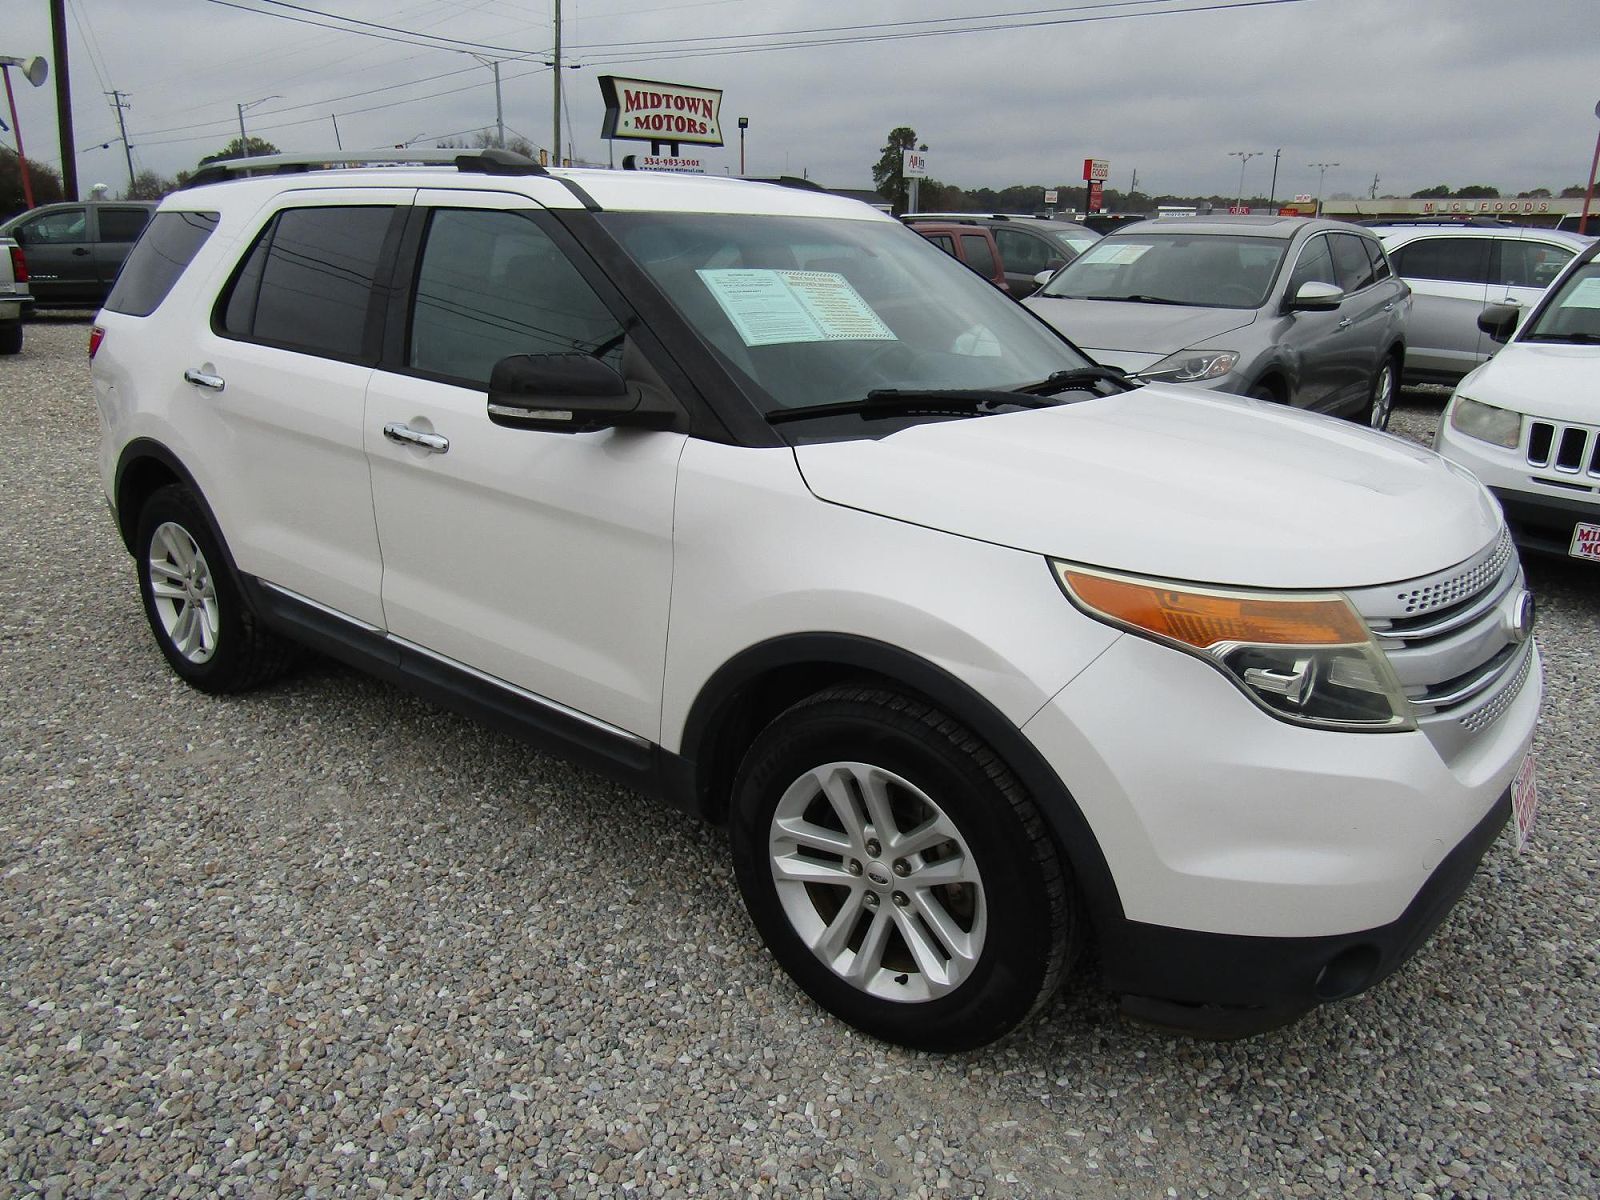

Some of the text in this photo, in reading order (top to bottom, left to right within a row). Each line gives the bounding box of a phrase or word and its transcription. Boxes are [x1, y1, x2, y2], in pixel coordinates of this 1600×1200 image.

[624, 90, 713, 120] MIDTOWN
[635, 115, 708, 134] MOTORS
[1480, 202, 1549, 212] FOODS
